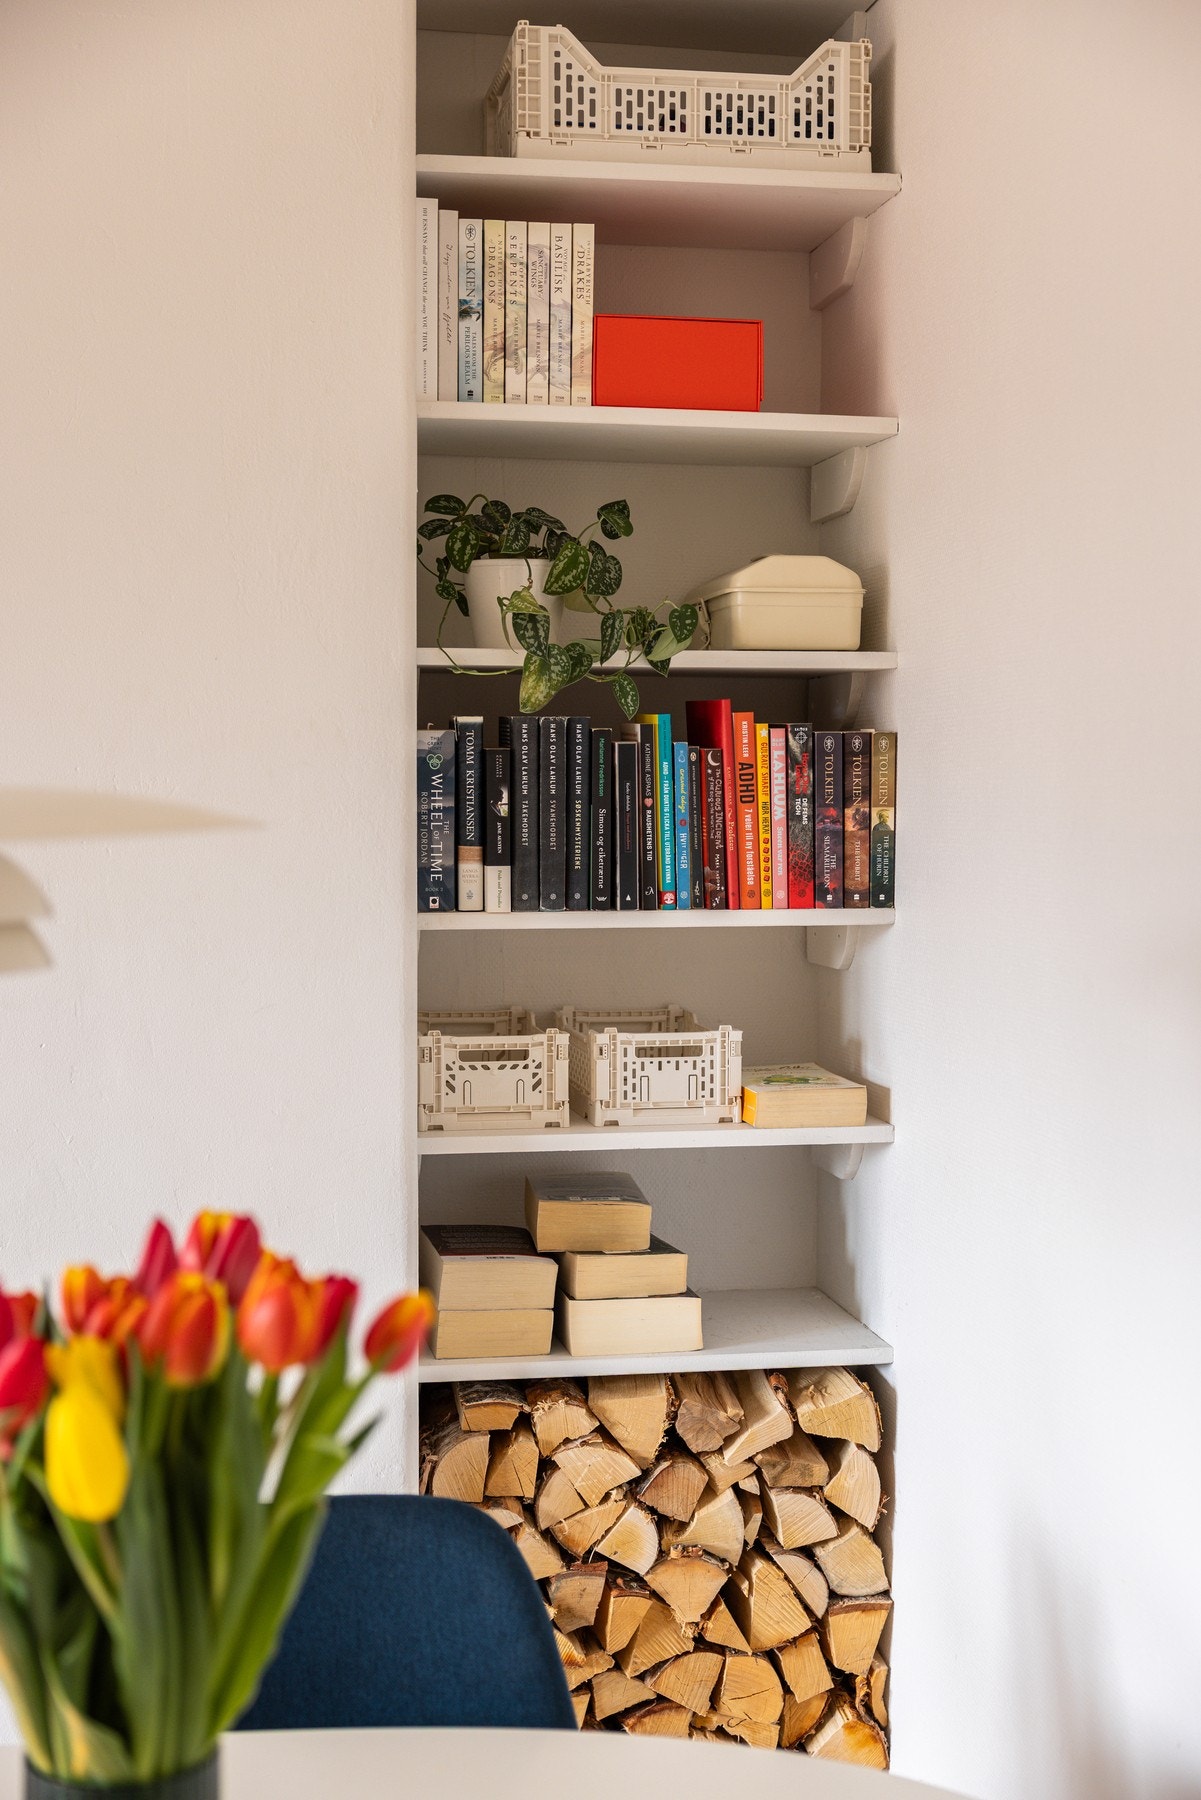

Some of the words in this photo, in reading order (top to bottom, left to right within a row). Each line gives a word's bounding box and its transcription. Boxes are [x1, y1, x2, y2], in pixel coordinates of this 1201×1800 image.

[465, 243, 475, 298] TOLKIEN
[488, 246, 496, 304] DRAGONS
[554, 235, 562, 294] BASILISK
[466, 730, 474, 764] TOMM
[760, 742, 768, 769] GULRAIZ
[663, 780, 671, 793] FRÅN
[738, 762, 755, 804] ADHD
[773, 750, 785, 820] LAHLUM
[825, 754, 834, 804] TOLKIEN
[852, 755, 862, 806] TOLKIEN
[879, 754, 888, 805] TOLKIEN
[430, 773, 442, 830] WHEEL
[466, 770, 474, 841] KRISTIANSEN
[598, 809, 606, 834] Simon
[761, 801, 769, 815] HØR
[802, 798, 808, 807] DE
[433, 831, 439, 840] OF
[574, 800, 582, 870] SØSKENMYSTERIENE
[596, 836, 605, 846] og
[745, 841, 752, 849] ny
[877, 844, 882, 853] OF
[430, 842, 442, 882] TIME
[598, 848, 606, 889] eiketrærne
[746, 851, 755, 885] forståelse
